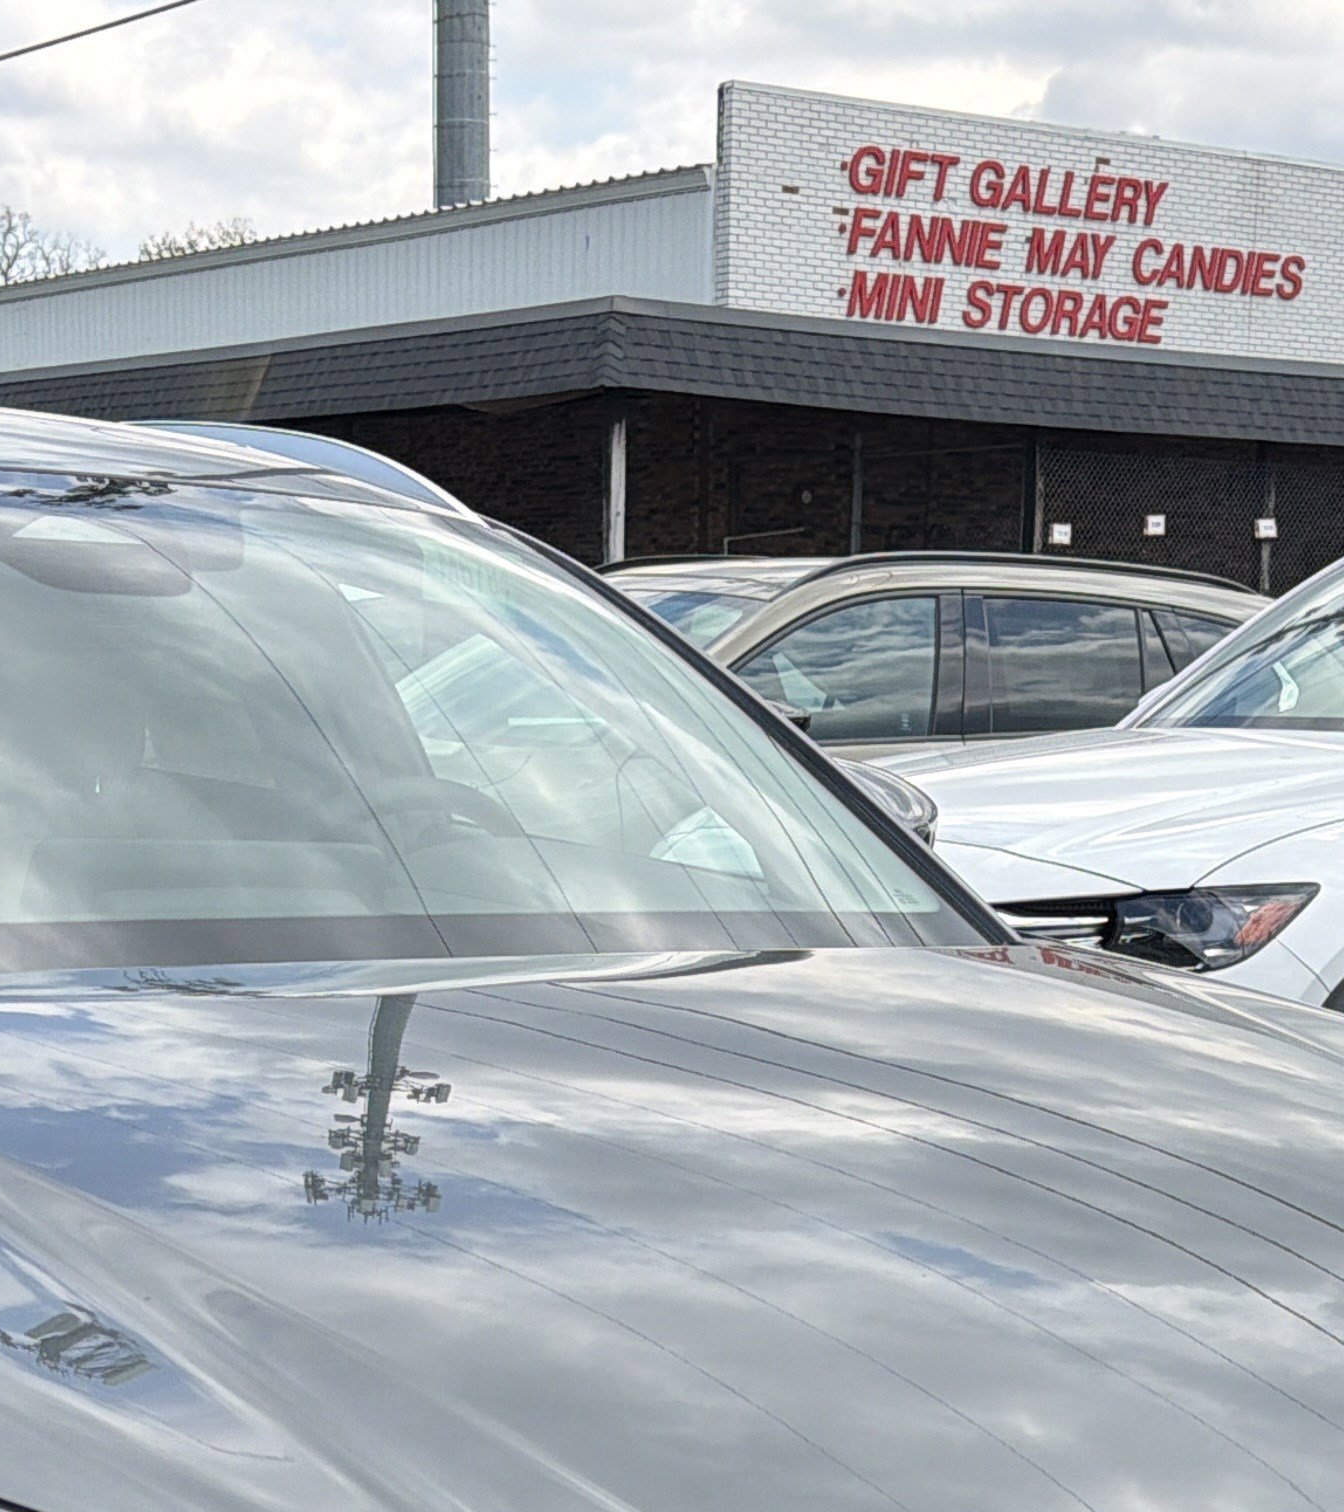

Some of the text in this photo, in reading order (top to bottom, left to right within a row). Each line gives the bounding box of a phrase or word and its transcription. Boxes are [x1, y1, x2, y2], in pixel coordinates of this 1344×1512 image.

[849, 145, 1168, 225] GIFT GALLERY
[846, 207, 1306, 300] FANNIE MAY CANDIES
[845, 269, 1168, 344] MINI STORAGE
